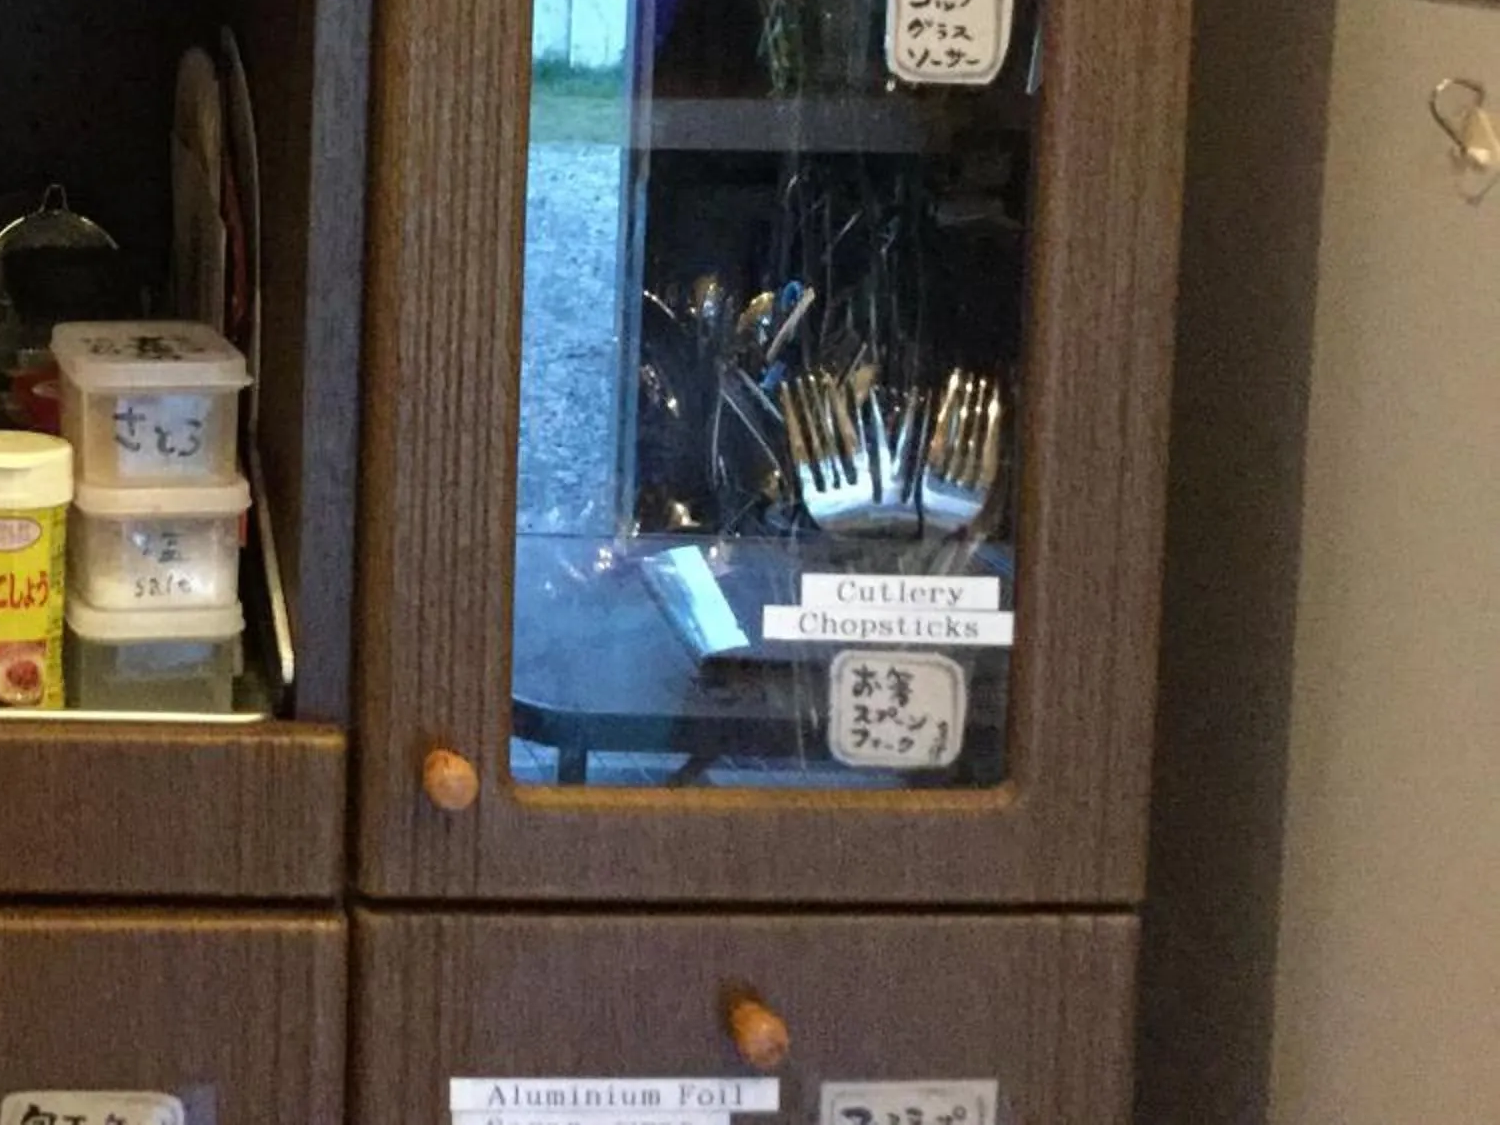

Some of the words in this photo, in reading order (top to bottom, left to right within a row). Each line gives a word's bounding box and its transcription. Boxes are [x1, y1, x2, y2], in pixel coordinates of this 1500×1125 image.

[908, 18, 973, 40] グラス
[908, 48, 981, 68] ソーサー
[836, 577, 964, 606] Cutlery
[798, 612, 979, 638] Chopsticks
[487, 1084, 661, 1107] Aluminium
[678, 1084, 743, 1106] Foil
